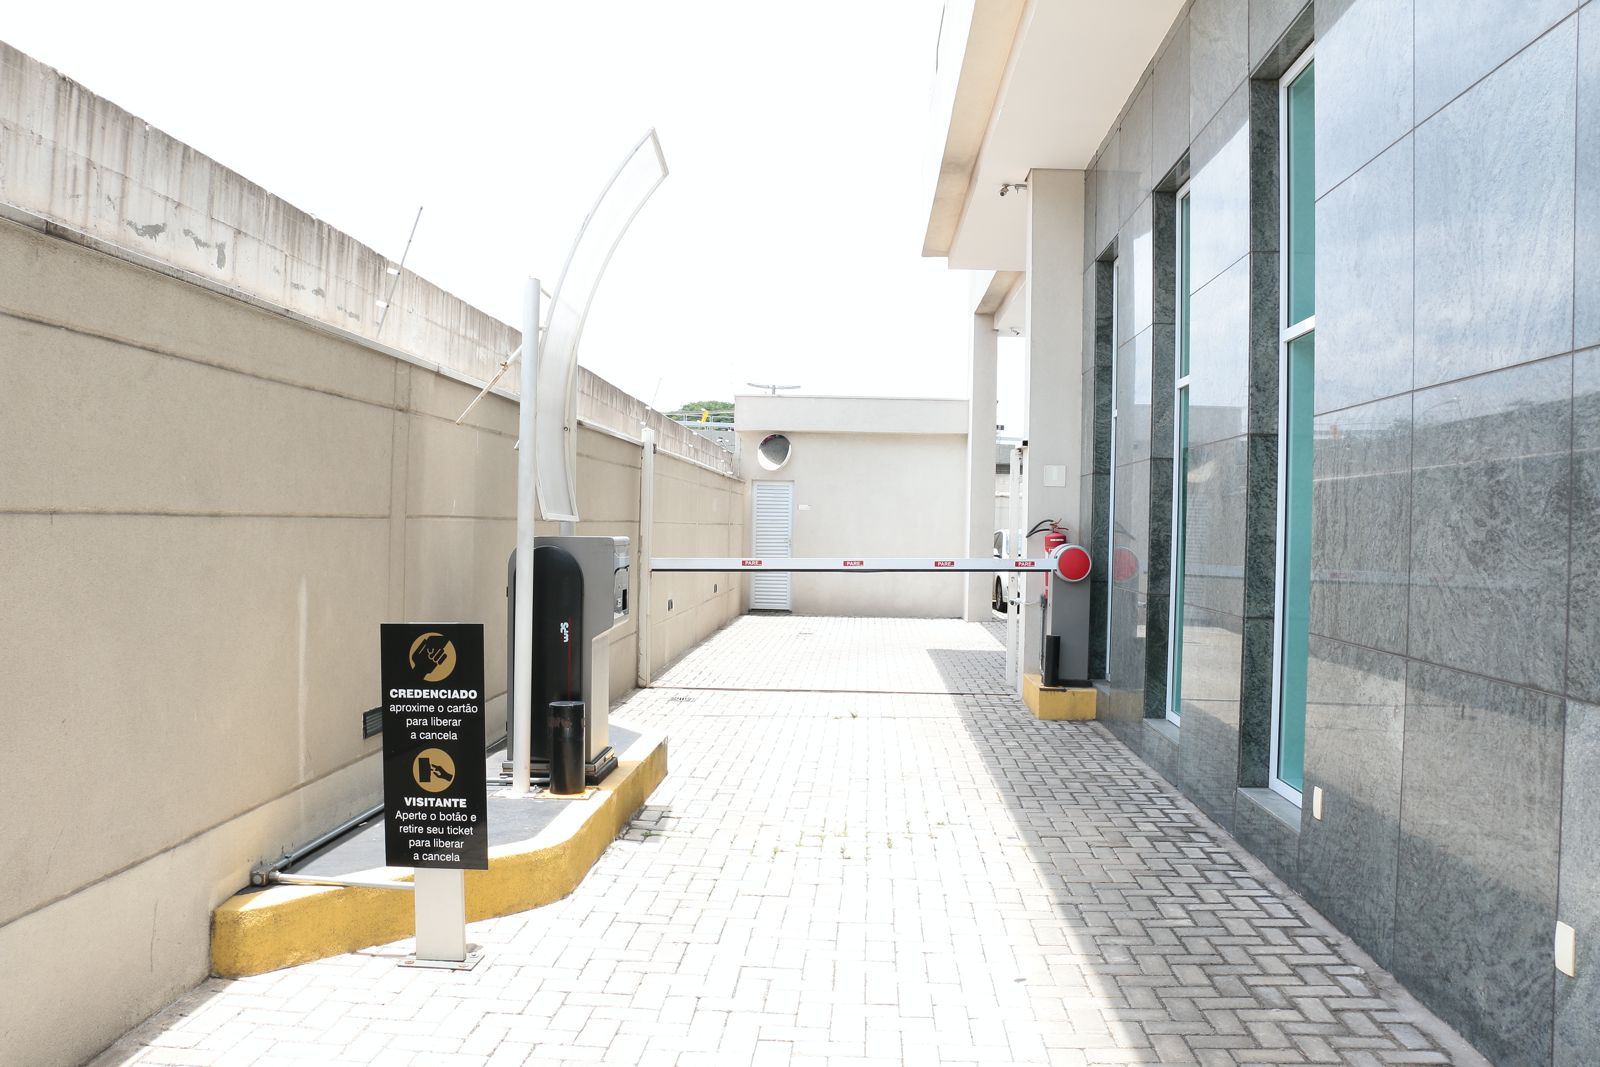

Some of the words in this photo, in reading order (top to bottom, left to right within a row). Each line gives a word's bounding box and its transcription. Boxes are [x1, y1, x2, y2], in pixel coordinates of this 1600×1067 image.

[389, 688, 478, 699] CREDENCIADO
[389, 703, 435, 714] aproxime
[437, 705, 444, 713] o
[446, 703, 478, 713] cartão
[406, 718, 428, 728] para
[430, 716, 462, 727] liberar
[410, 731, 417, 740] a
[419, 731, 458, 740] cancela
[404, 797, 467, 808] VISITANTE
[395, 810, 427, 821] Aperte
[430, 813, 437, 821] o
[439, 811, 467, 822] botão
[470, 814, 477, 822] e
[399, 824, 424, 834] retire
[426, 826, 444, 835] seu
[446, 825, 474, 835] ticket
[408, 839, 431, 849] para
[433, 838, 464, 848] liberar
[413, 852, 420, 860] a
[422, 852, 460, 862] cancela
